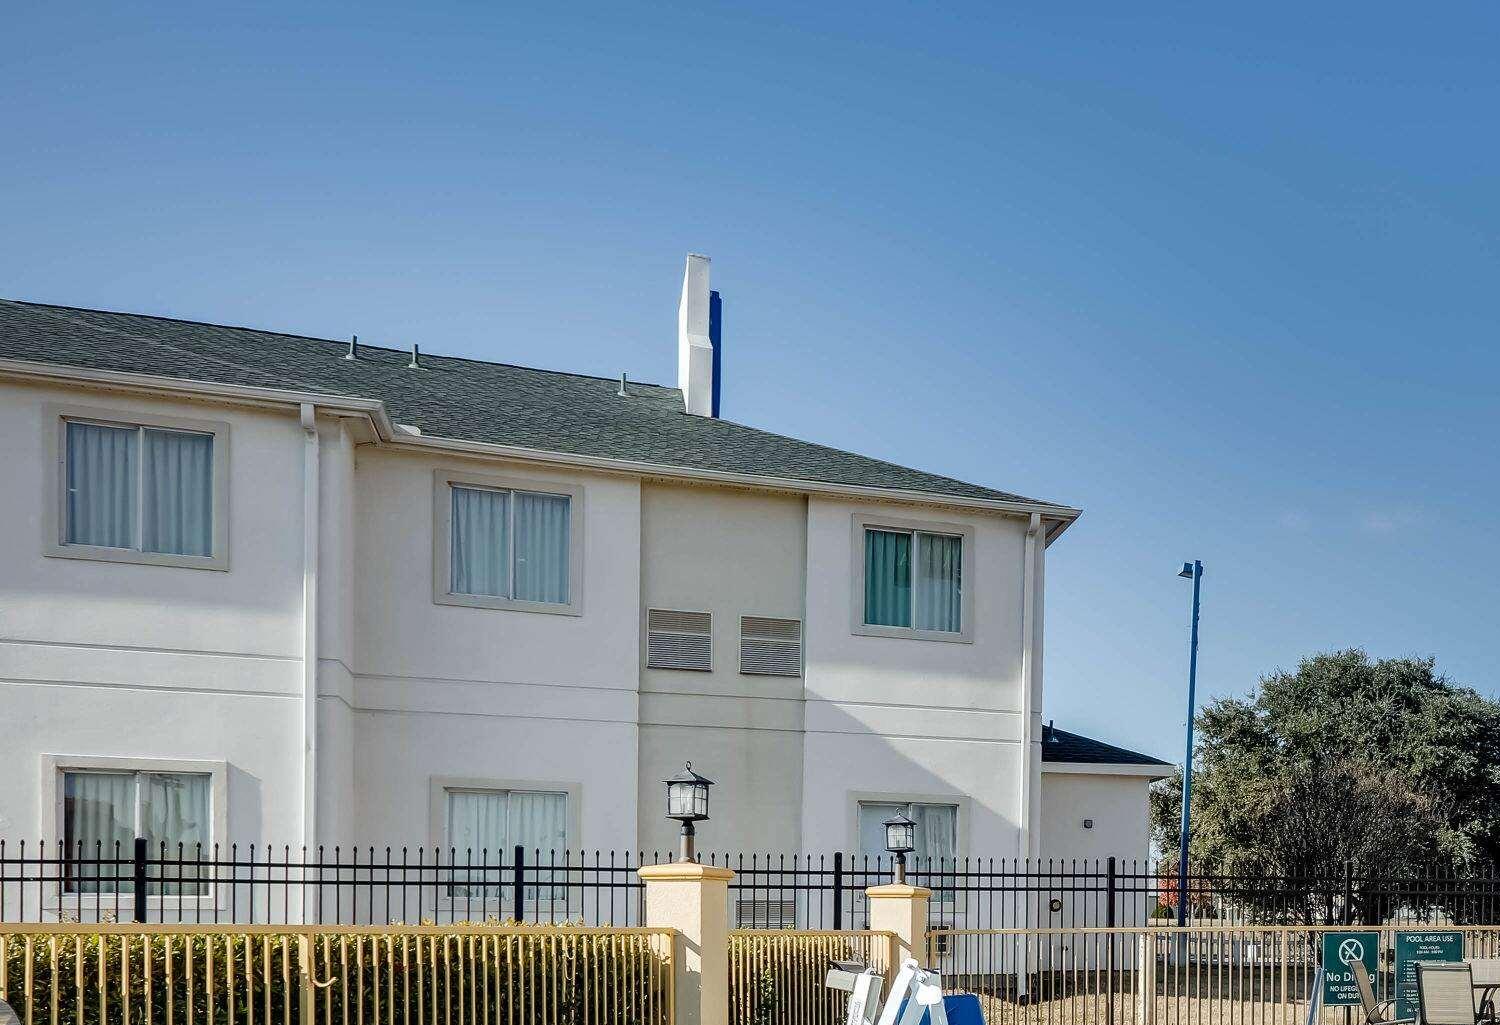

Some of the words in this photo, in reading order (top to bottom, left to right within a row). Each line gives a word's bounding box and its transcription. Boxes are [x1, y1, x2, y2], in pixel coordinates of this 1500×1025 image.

[1406, 935, 1423, 943] POOL
[1326, 972, 1341, 982] No
[1343, 972, 1376, 984] Dig
